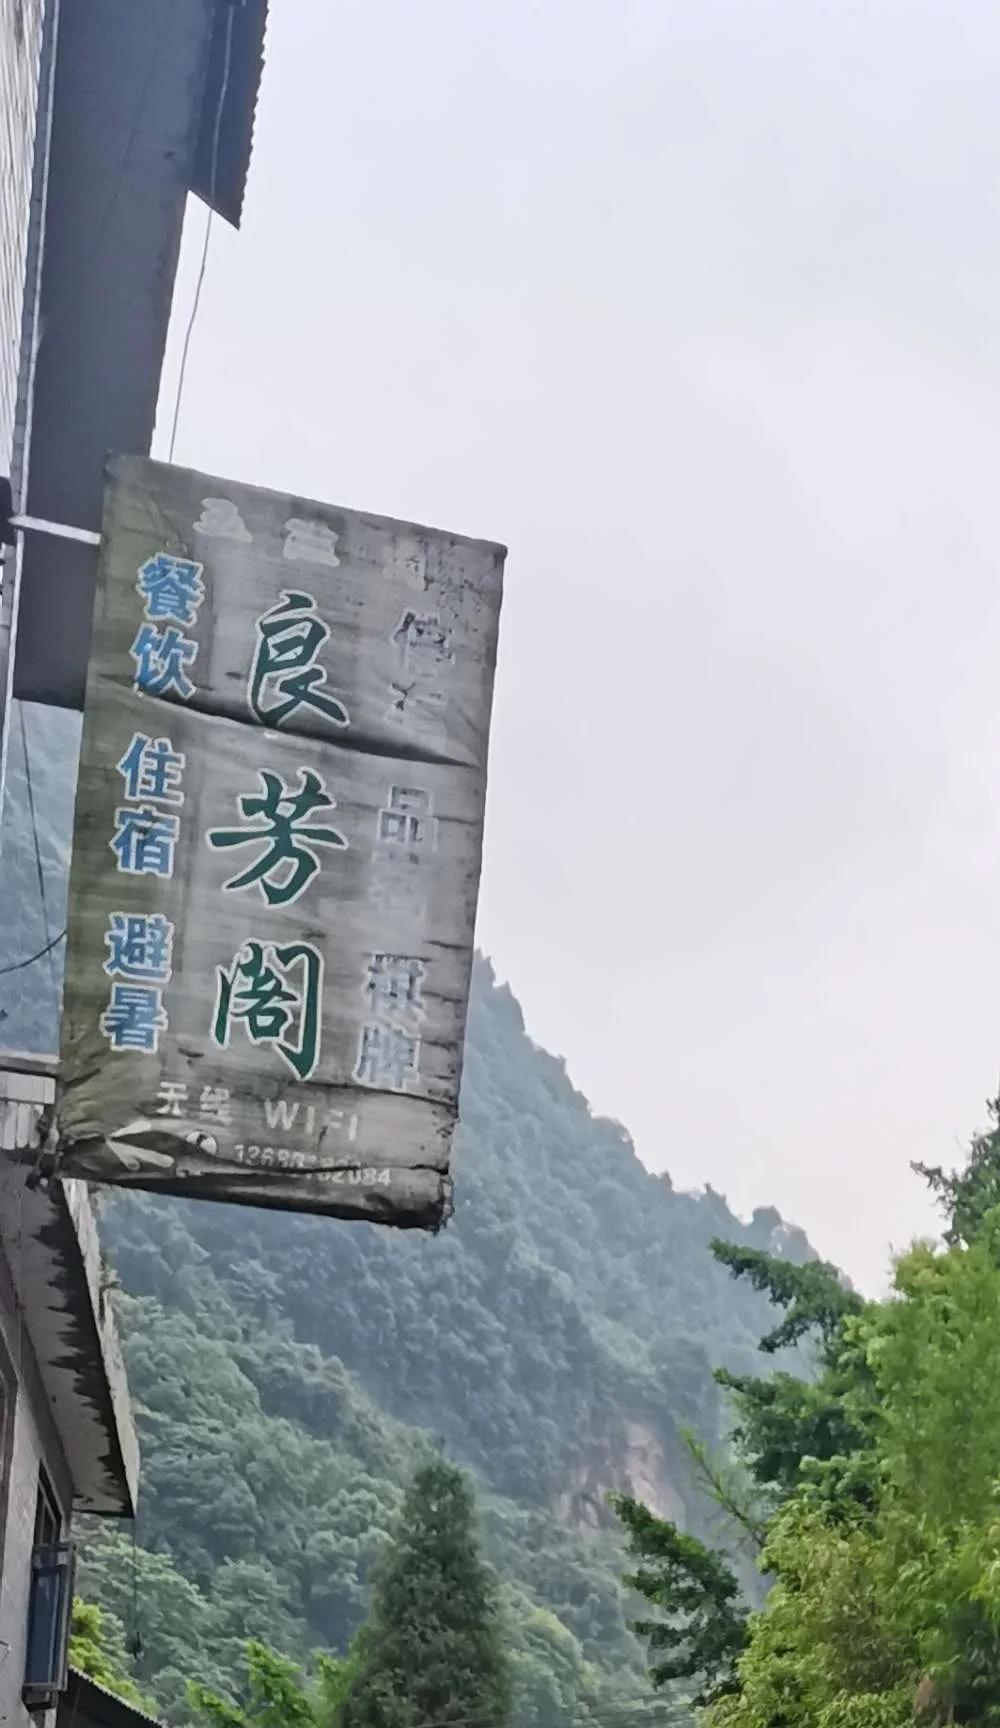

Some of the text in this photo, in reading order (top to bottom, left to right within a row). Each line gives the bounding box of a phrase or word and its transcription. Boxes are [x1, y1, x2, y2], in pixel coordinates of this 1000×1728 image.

[100, 552, 205, 1054] 餐饮 住宿 避暑
[264, 1098, 358, 1142] WIFI
